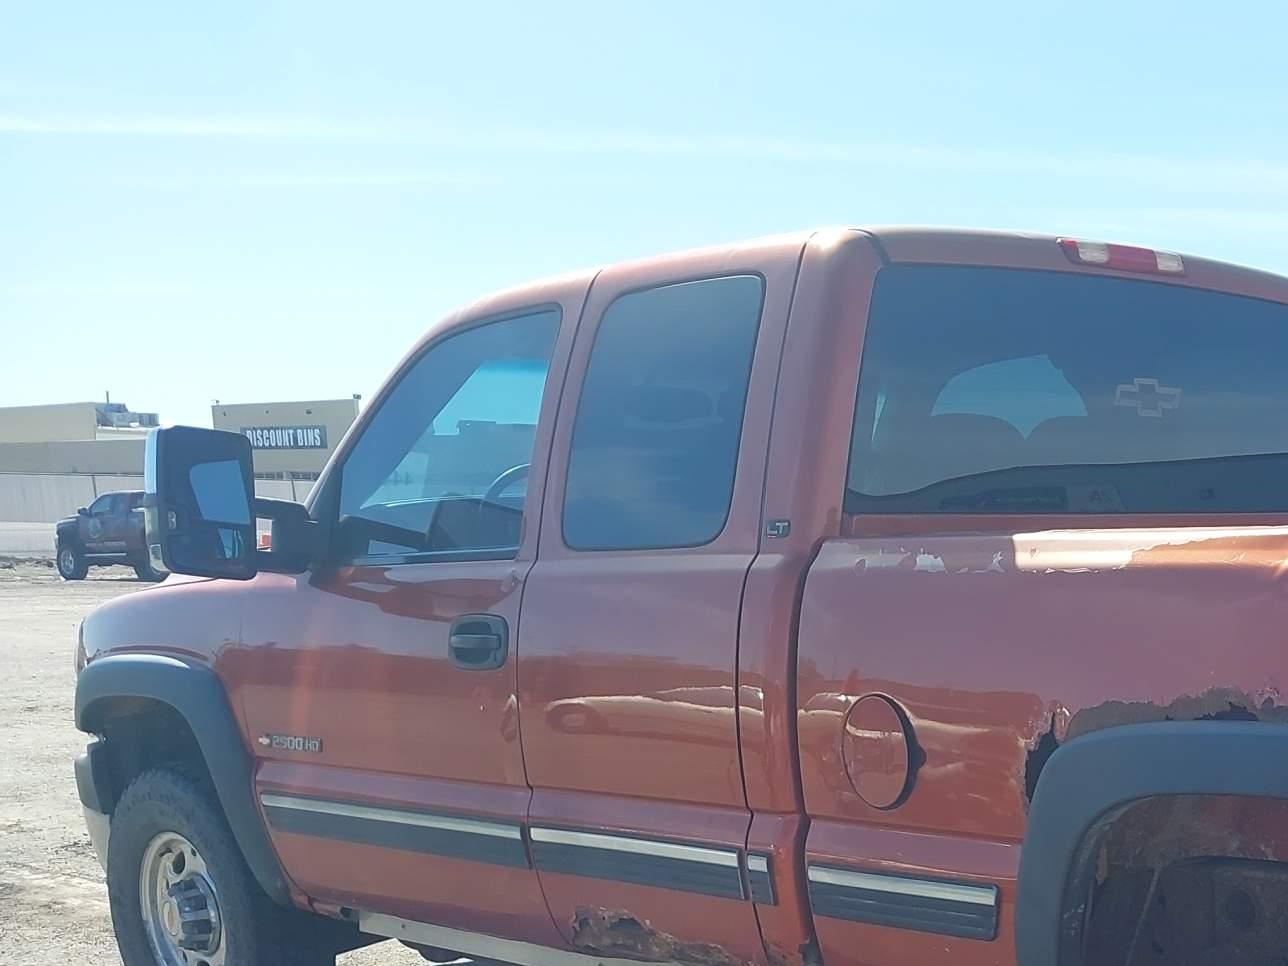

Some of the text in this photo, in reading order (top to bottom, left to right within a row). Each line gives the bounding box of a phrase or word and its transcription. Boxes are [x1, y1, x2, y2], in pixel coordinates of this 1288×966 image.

[297, 428, 321, 447] BINS
[767, 522, 789, 535] LT
[272, 736, 319, 751] 2500 HD
